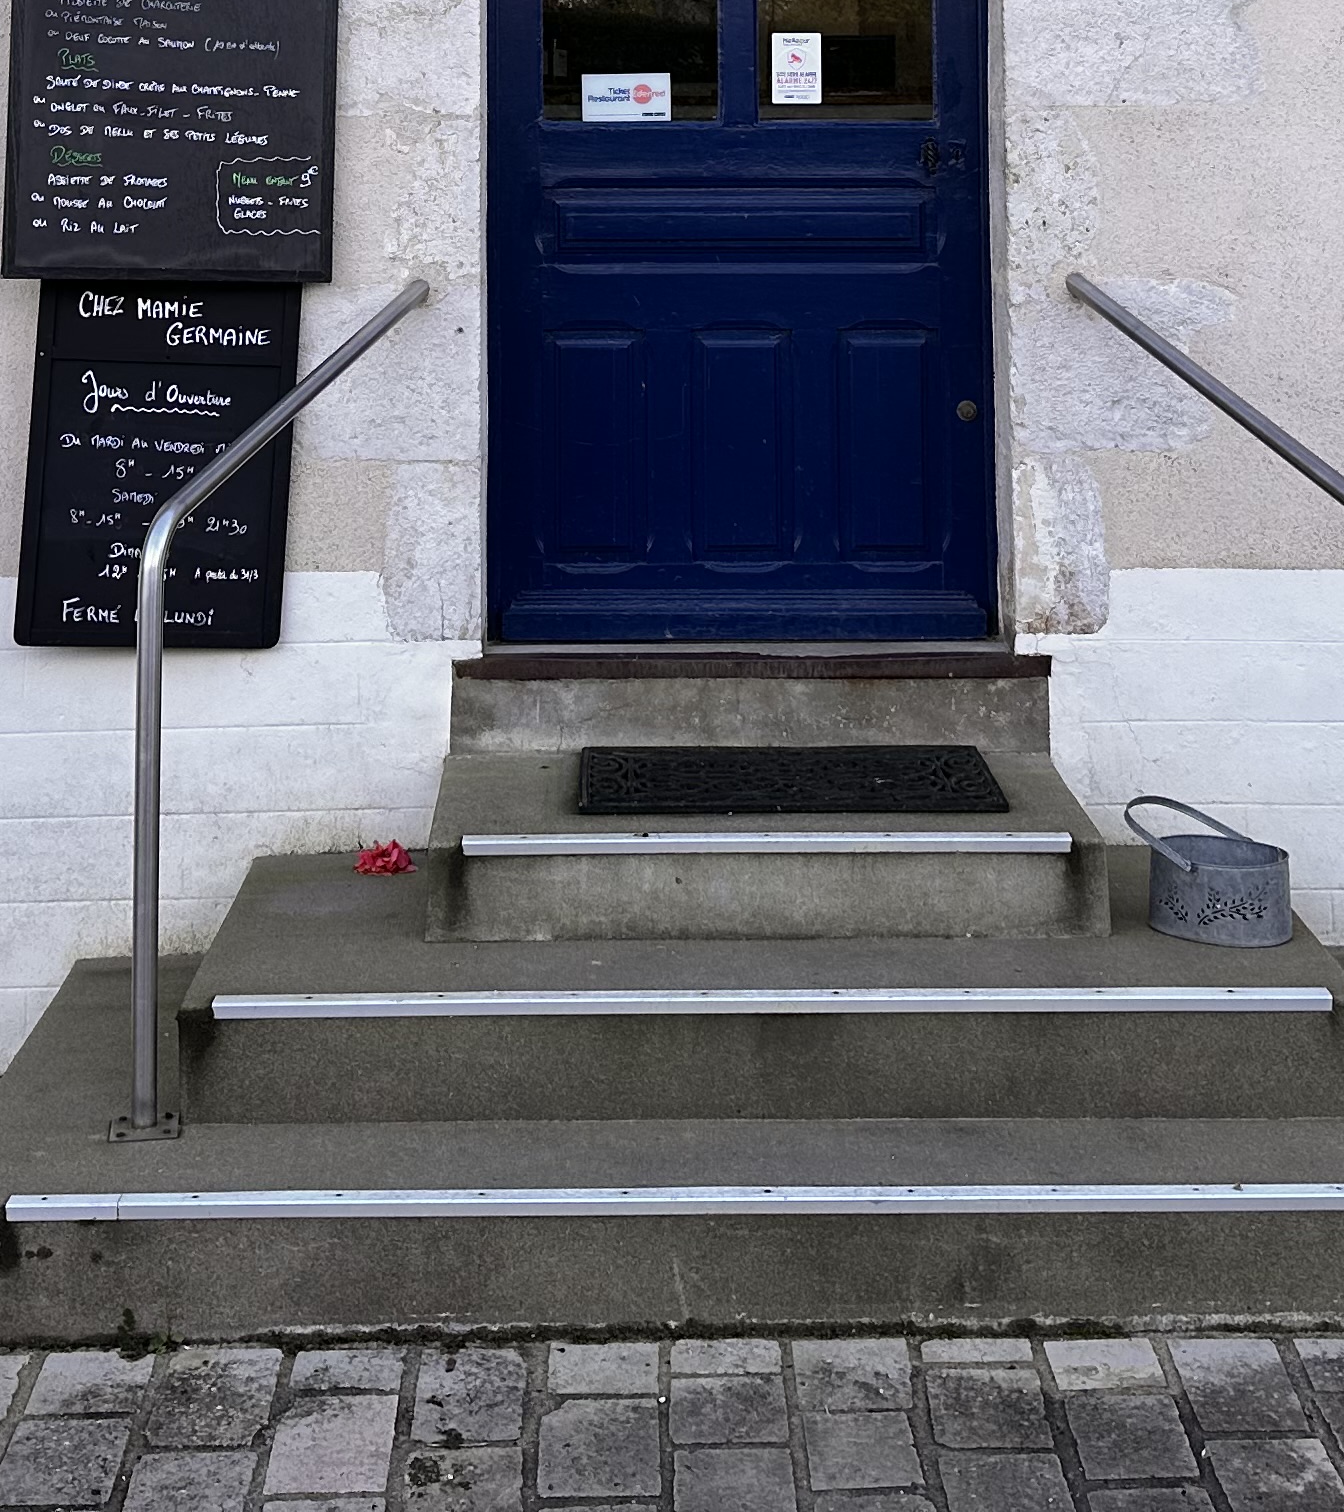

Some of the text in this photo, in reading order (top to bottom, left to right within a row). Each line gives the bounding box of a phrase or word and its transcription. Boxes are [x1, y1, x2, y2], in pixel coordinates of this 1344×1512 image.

[58, 48, 96, 66] PLATS
[587, 95, 630, 103] Restaurant
[79, 291, 204, 319] CHEZ MAMIE
[166, 322, 272, 346] GERMAINE
[81, 370, 129, 413] Jours
[91, 435, 124, 449] MARDI
[154, 439, 205, 455] VENDREDI
[115, 458, 135, 479] 8H
[161, 464, 195, 480] 15H
[111, 488, 158, 505] SAMEDI
[62, 597, 122, 623] FERMÉ
[164, 608, 215, 626] LUNDI
